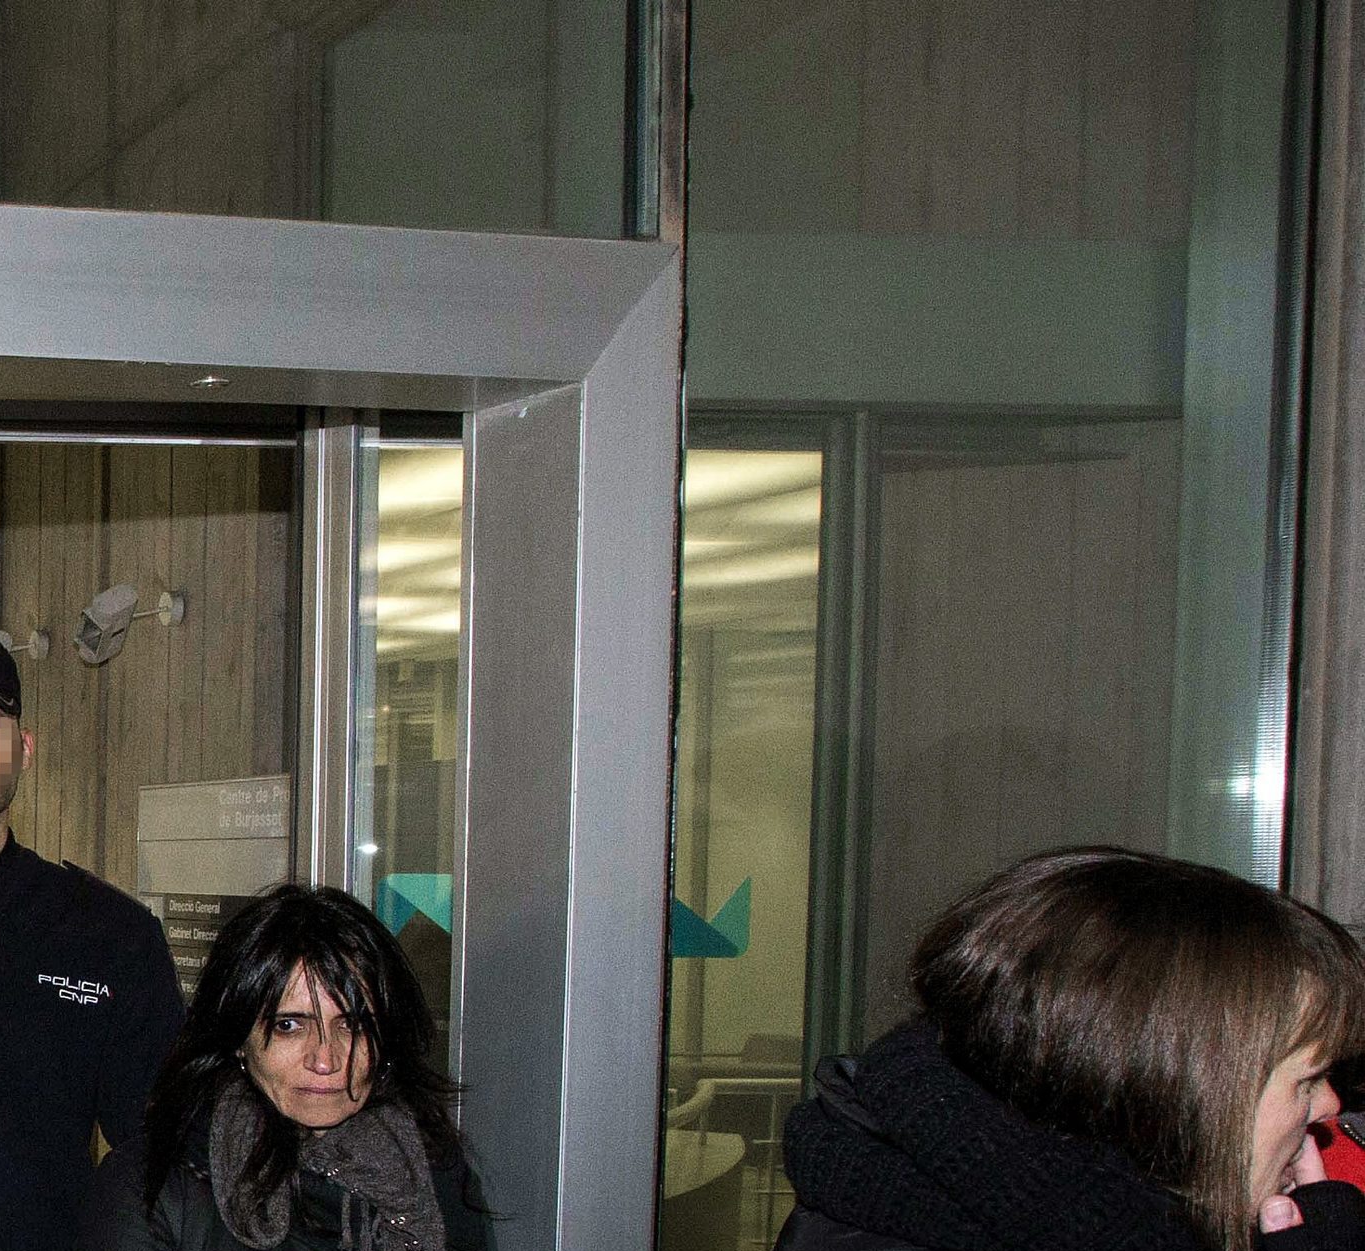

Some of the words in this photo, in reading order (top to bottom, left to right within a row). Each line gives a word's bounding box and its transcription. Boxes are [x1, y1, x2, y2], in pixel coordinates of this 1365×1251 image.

[195, 900, 220, 914] General
[38, 974, 110, 997] POLICIA
[58, 989, 98, 1005] CNP
